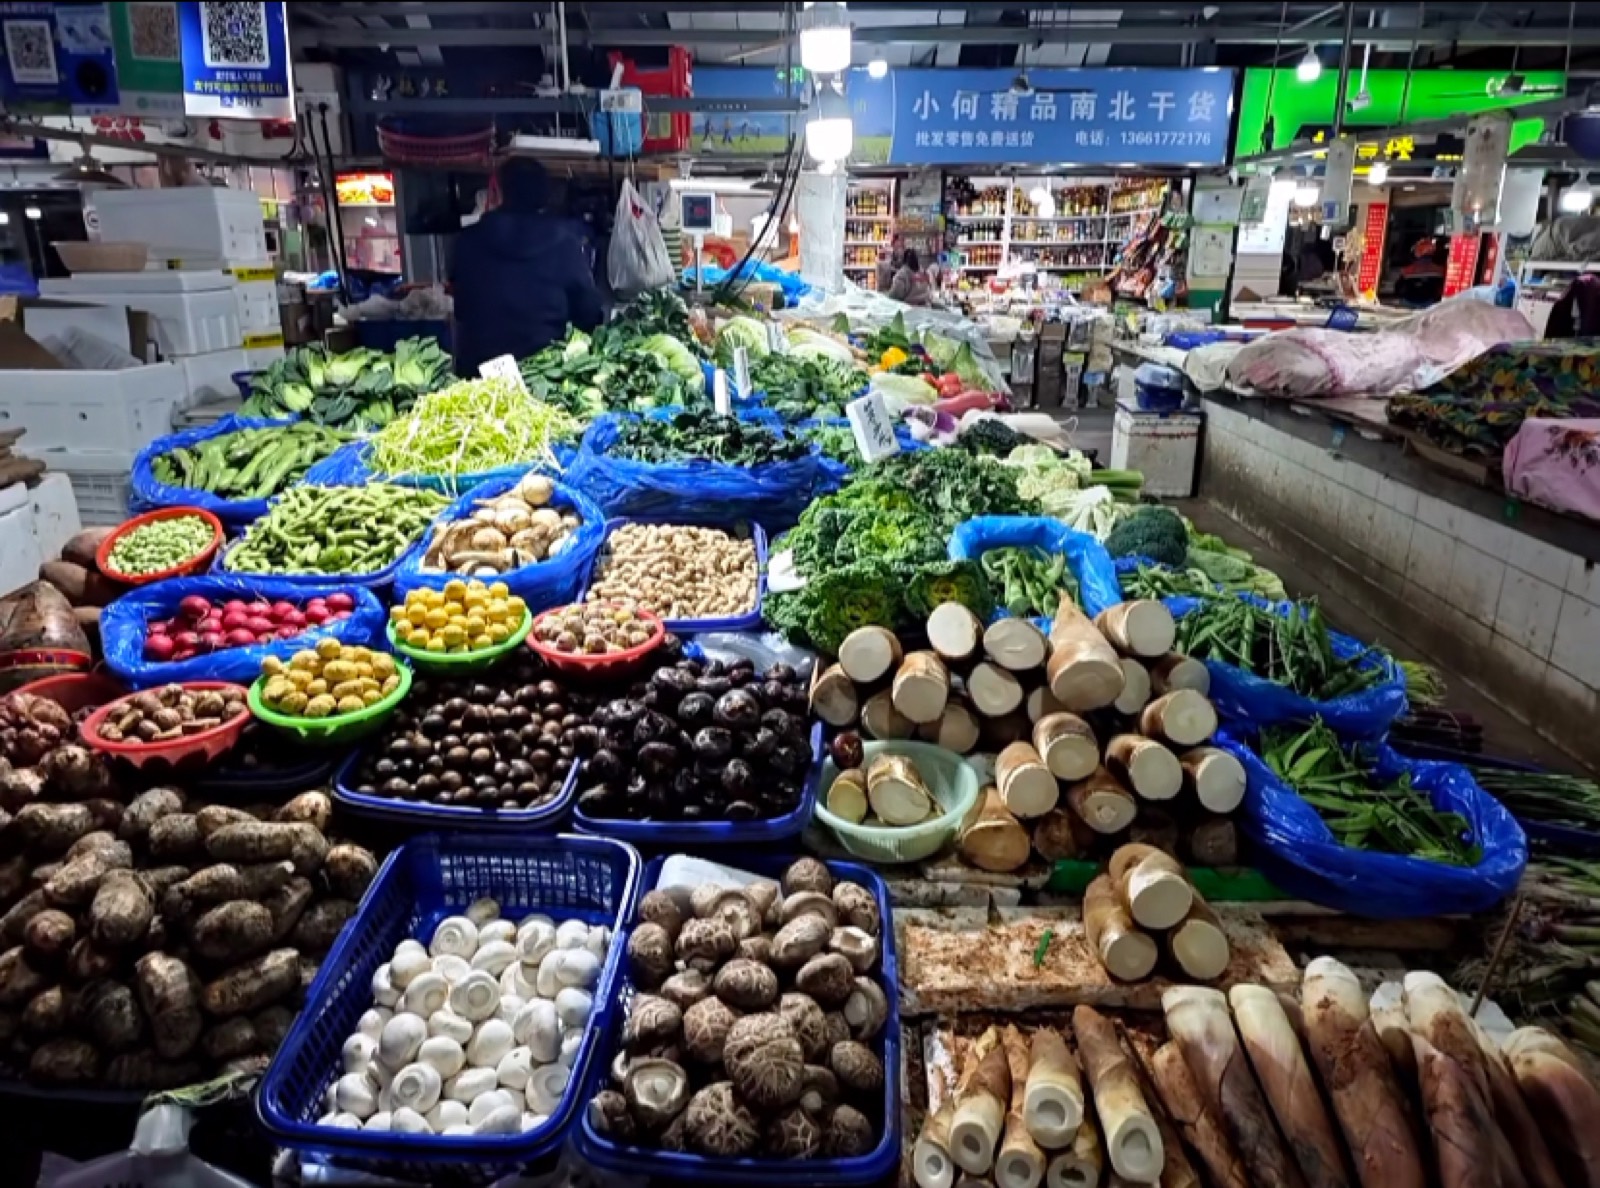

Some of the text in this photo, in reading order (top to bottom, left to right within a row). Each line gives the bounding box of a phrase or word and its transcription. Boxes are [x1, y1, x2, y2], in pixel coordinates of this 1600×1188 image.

[912, 91, 1216, 121] 小何精品南北干货
[1120, 131, 1211, 146] 13661772176
